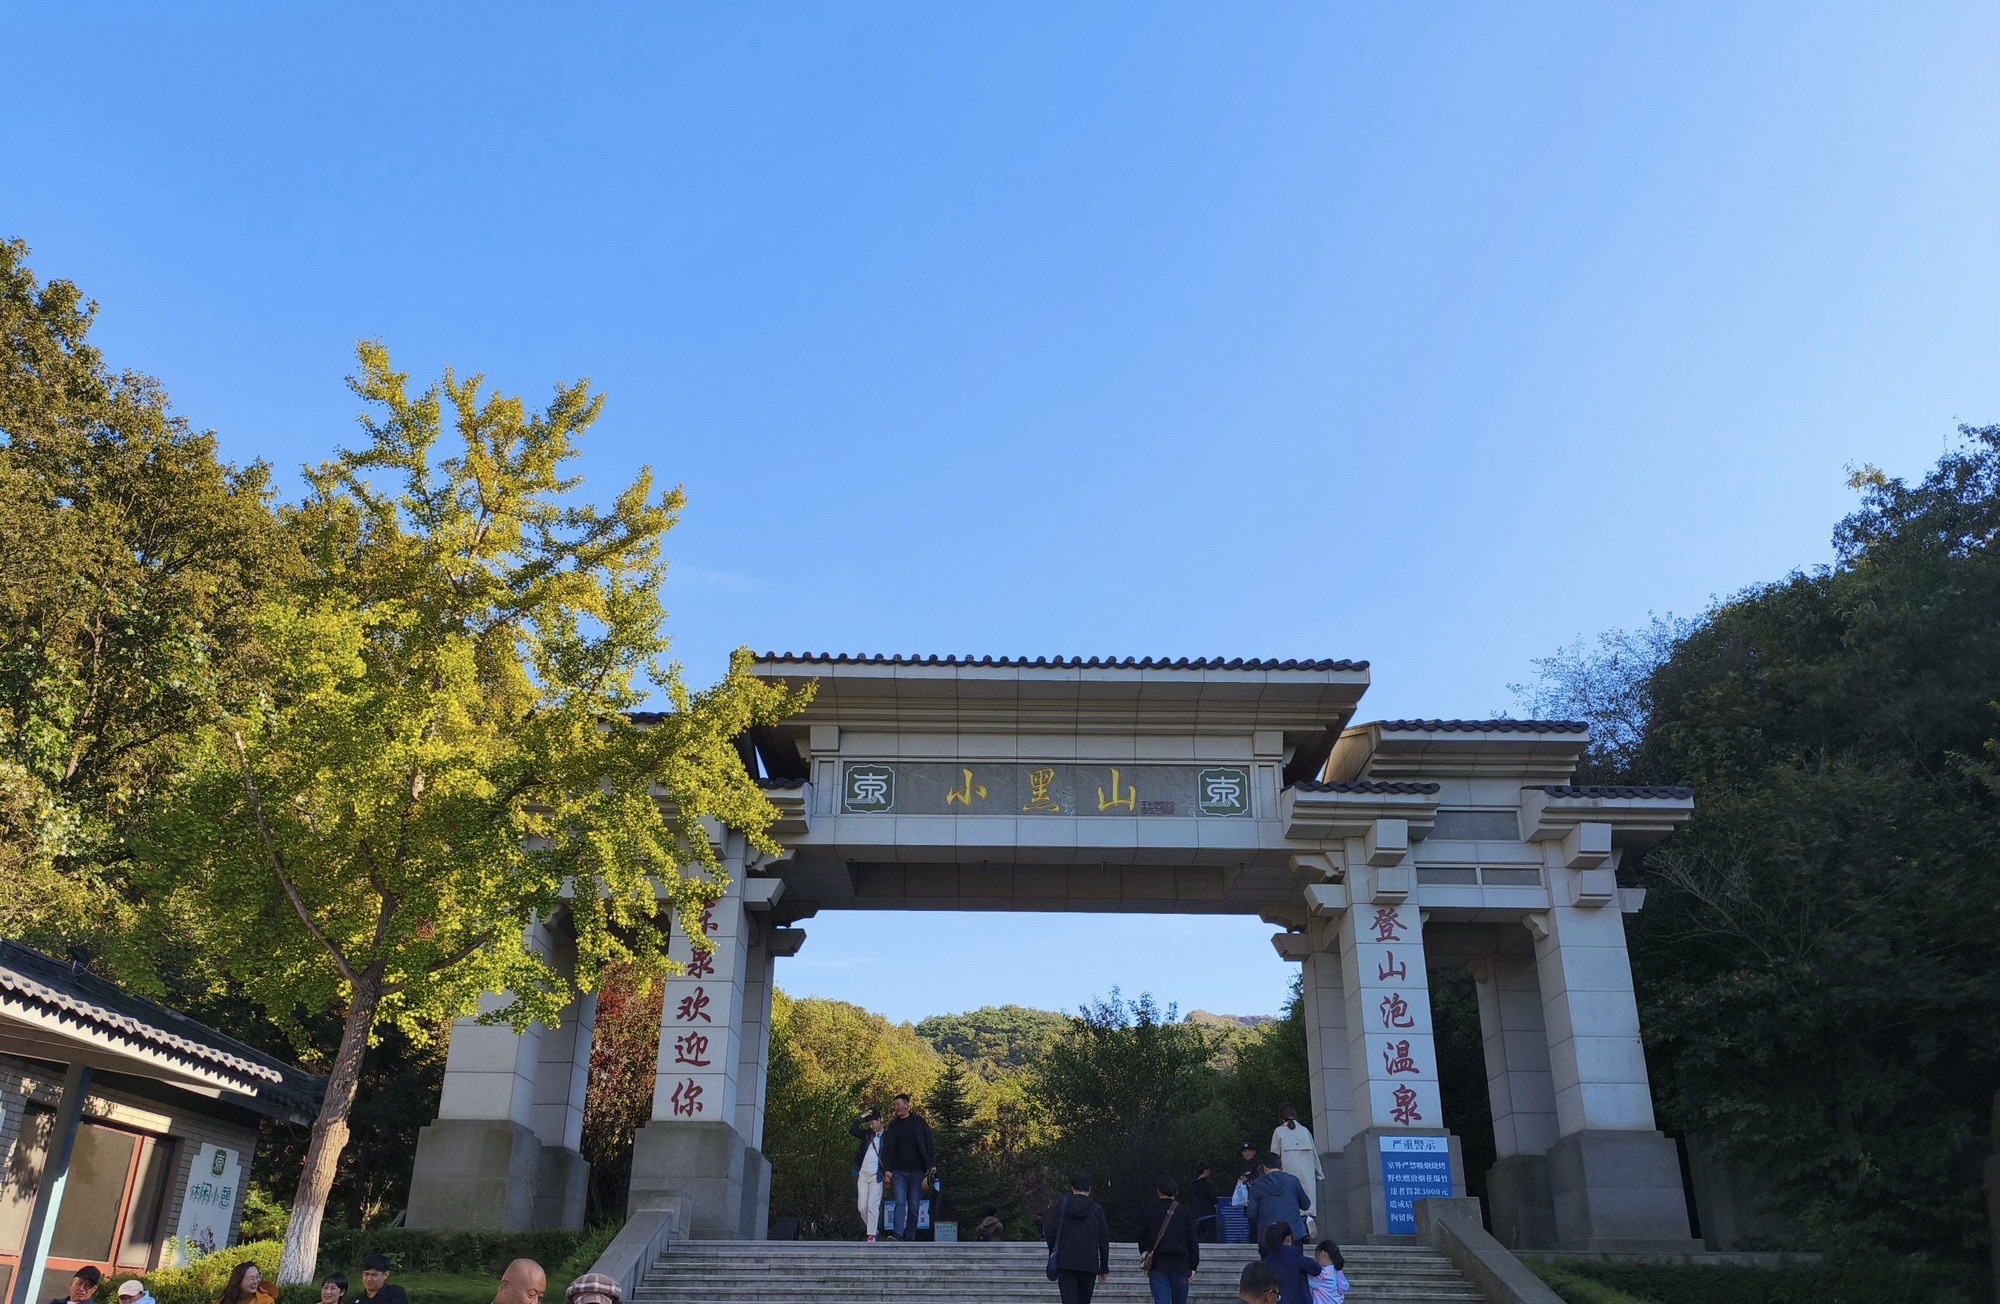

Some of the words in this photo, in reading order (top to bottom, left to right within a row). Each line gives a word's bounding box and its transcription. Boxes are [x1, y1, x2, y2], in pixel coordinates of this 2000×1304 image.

[946, 767, 1137, 813] 小黑山
[1370, 907, 1423, 1126] 登山泡温泉
[1392, 1138, 1436, 1151] 严重警示
